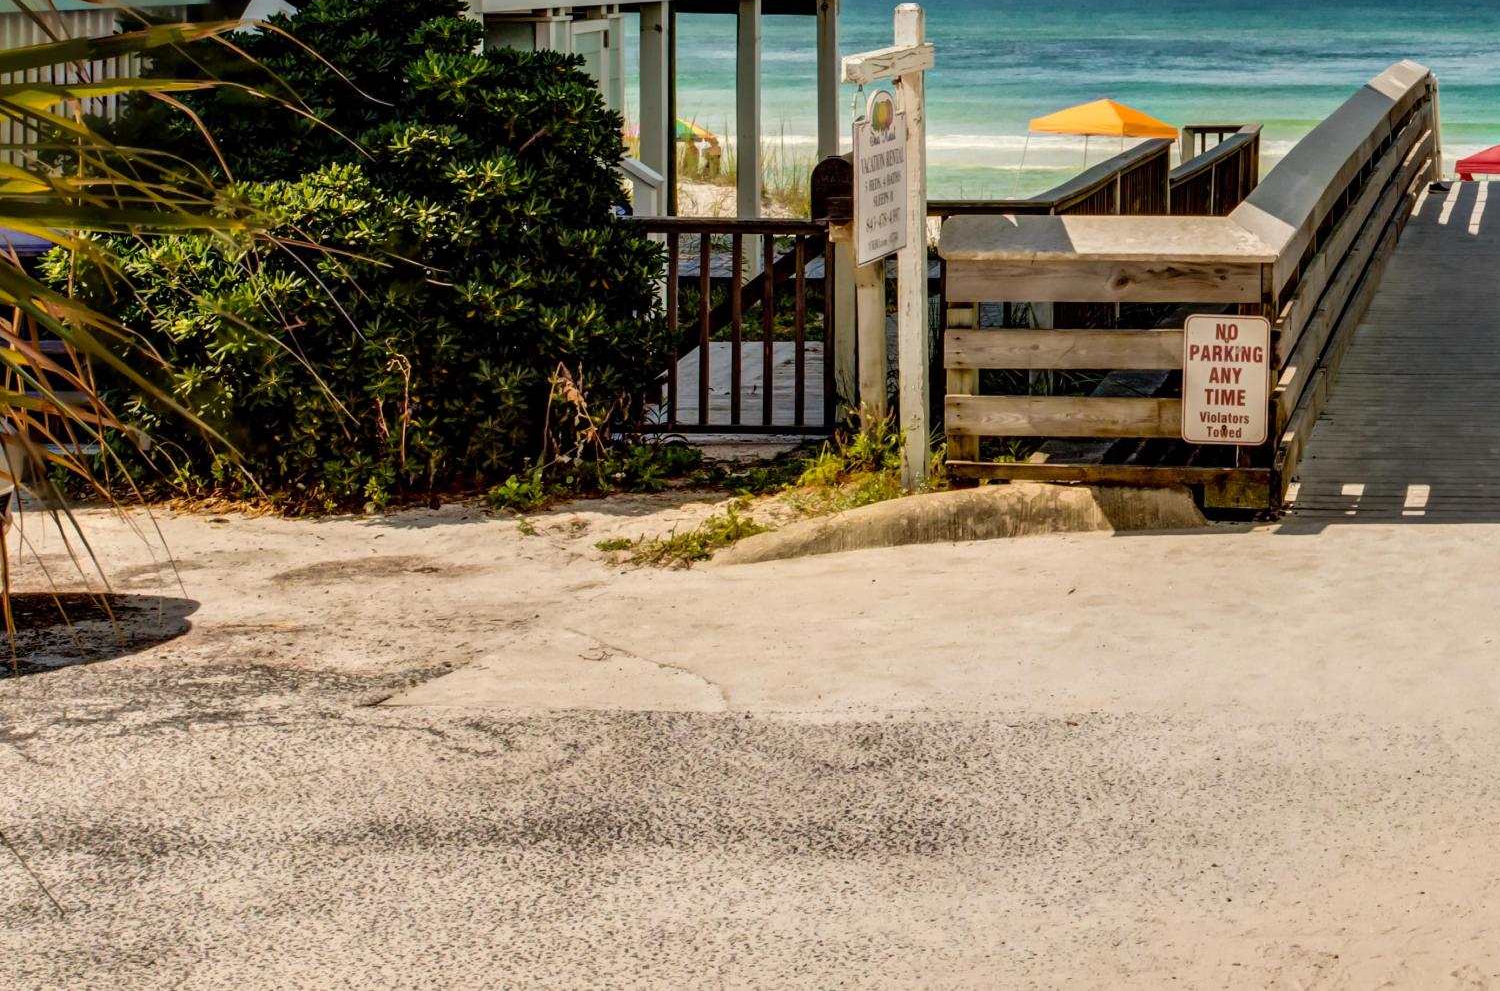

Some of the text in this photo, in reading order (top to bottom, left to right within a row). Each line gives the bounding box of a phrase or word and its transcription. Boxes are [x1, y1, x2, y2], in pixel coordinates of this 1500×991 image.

[861, 147, 904, 175] VACATION RENTAL
[1215, 323, 1238, 340] NO
[1189, 344, 1263, 363] PARKING
[1209, 367, 1243, 384] ANY
[1204, 388, 1246, 406] TIME
[1200, 411, 1249, 424] Violators
[1206, 426, 1242, 439] Towed
